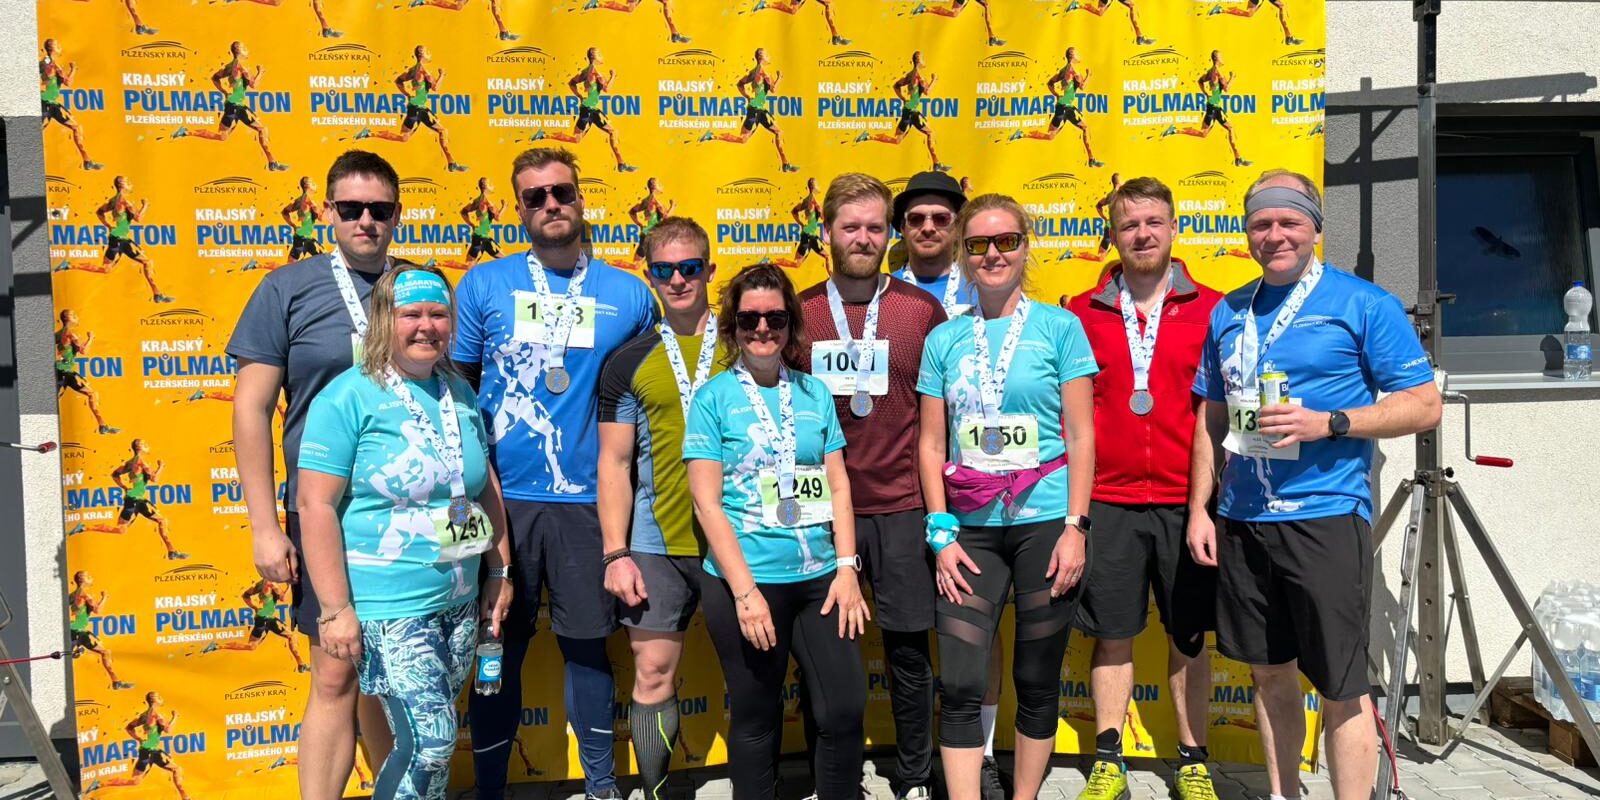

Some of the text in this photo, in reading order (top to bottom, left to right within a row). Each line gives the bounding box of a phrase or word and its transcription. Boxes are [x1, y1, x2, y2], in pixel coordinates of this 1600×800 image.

[121, 50, 186, 60] PLZEŇSKÝ KRAJ
[308, 51, 370, 62] PLZEŇSKÝ KRAJ
[486, 53, 546, 65] PLZEŇSKÝ KRAJ
[658, 56, 715, 68] PLZEŇSKÝ KRAJ
[818, 58, 874, 69] PLZEŇSKÝ KRAJ
[1161, 57, 1179, 66] KRAJ
[122, 71, 186, 87] KRAJSKÝ
[309, 74, 369, 88] KRAJSKÝ
[487, 76, 545, 91] KRAJSKÝ
[658, 78, 714, 92] KRAJSKÝ
[1123, 76, 1178, 91] KRAJSKÝ
[818, 80, 872, 94] KRAJSKÝ
[976, 80, 1025, 94] KRAJSKÝ
[124, 88, 291, 113] PŮLMARTON
[310, 89, 471, 115] PŮLMARTON
[488, 92, 641, 116] PŮLMARTON
[659, 93, 803, 117] PŮLMARTON
[818, 94, 959, 118] PŮLMARTON
[975, 94, 1108, 117] PŮLMARTON
[1123, 91, 1256, 114] PŮLMARTON
[125, 114, 215, 125] PLZEŇSKÉHO KRAJE
[312, 115, 397, 126] PLZEŇSKÉHO KRAJE
[488, 117, 570, 128] PLZEŇSKÉHO KRAJE
[659, 118, 737, 129] PLZEŇSKÉHO KRAJE
[818, 119, 893, 130] PLZEŇSKÉHO KRAJE
[1022, 117, 1046, 128] KRAJE
[194, 185, 257, 195] PLZEŇSKÝ KRAJ
[716, 185, 753, 195] PLZEŇSKÝ
[1023, 180, 1077, 191] PLZEŇSKÝ KRAJ
[1179, 199, 1226, 212] KRAJSKÝ
[195, 206, 256, 221] KRAJSKÝ
[717, 207, 771, 221] KRAJSKÝ
[1072, 239, 1096, 248] KRAJE
[69, 249, 99, 258] KRAJE
[198, 247, 284, 258] PLZEŇSKÉHO KRAJE
[435, 248, 462, 256] KRAJE
[605, 247, 630, 256] KRAJE
[769, 245, 792, 255] KRAJE
[140, 317, 203, 327] PLZEŇSKÝ KRAJ
[141, 338, 204, 353] KRAJSKÝ
[144, 378, 230, 389] PLZEŇSKÉHO KRAJE
[969, 426, 1028, 446] 150
[64, 451, 84, 459] KRAJ
[83, 511, 113, 520] KRAJE
[154, 573, 217, 583] PLZEŇSKÝ KRAJ
[155, 592, 217, 608] KRAJSKÝ
[156, 630, 245, 644] PLZEŇSKÉHO KRAJE
[225, 688, 286, 700] PLZEŇSKÝ KRAJ
[226, 706, 286, 726] KRAJSKÝ
[226, 747, 282, 761] PLZEŇSKÉHO
[98, 763, 128, 777] KRAJE
